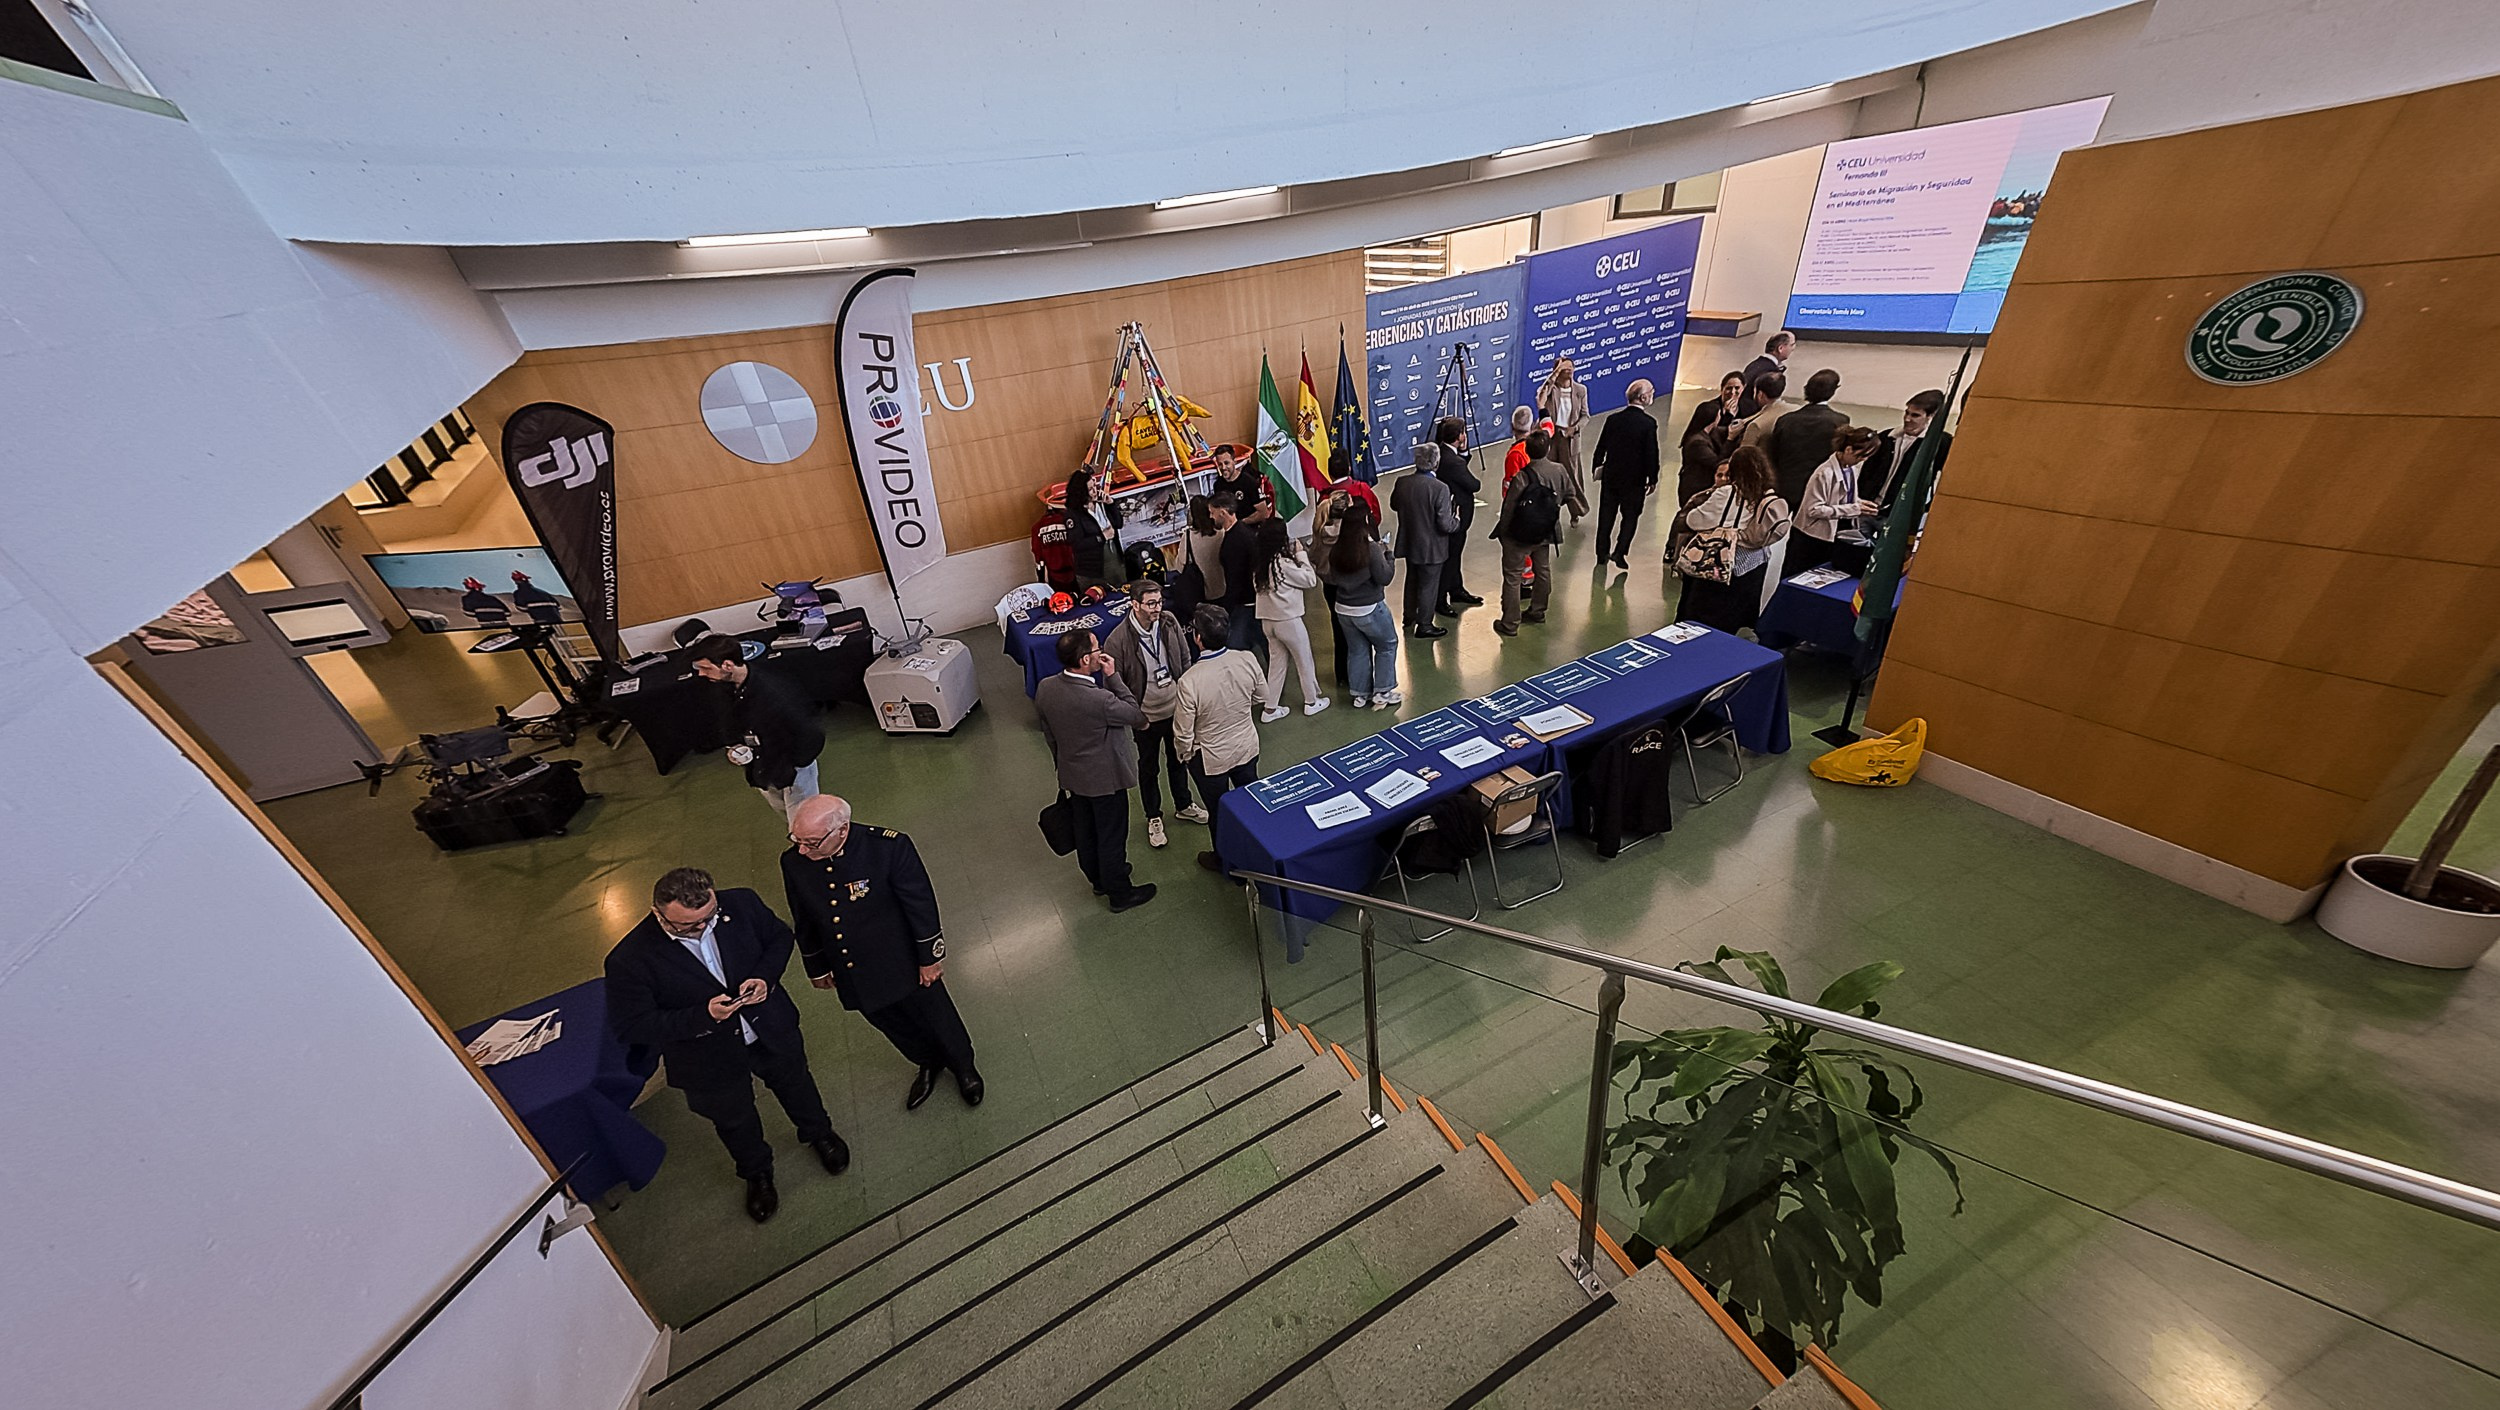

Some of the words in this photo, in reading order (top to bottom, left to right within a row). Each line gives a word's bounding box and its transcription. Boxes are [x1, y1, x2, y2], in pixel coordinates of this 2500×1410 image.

[1848, 157, 1867, 168] CEU
[1868, 150, 1926, 165] Universidad
[1844, 171, 1878, 180] Fernando
[1829, 188, 1865, 199] Seminario
[1867, 187, 1876, 195] de
[1879, 183, 1918, 195] Migración
[1920, 183, 1926, 191] y
[1927, 177, 1973, 190] Seguridad
[1836, 200, 1843, 208] el
[1845, 197, 1896, 207] Mediterráneo
[1613, 250, 1641, 272] CEU
[2219, 277, 2321, 312] INTERNATIONAL
[2242, 292, 2324, 311] SOSTENIBLE
[2327, 284, 2353, 321] COUNCIL
[1366, 319, 1424, 350] ERGENCIAS
[1426, 317, 1435, 336] Y
[1436, 301, 1509, 334] CATÁSTROFES
[1396, 312, 1421, 322] JORNADAS
[1422, 308, 1437, 317] SOBRE
[2325, 332, 2342, 346] OF
[2225, 357, 2310, 380] SUSTAINABLE
[858, 332, 926, 549] PROVIDEO
[1042, 531, 1067, 544] RESCAT
[600, 491, 614, 620] www.provideo.es
